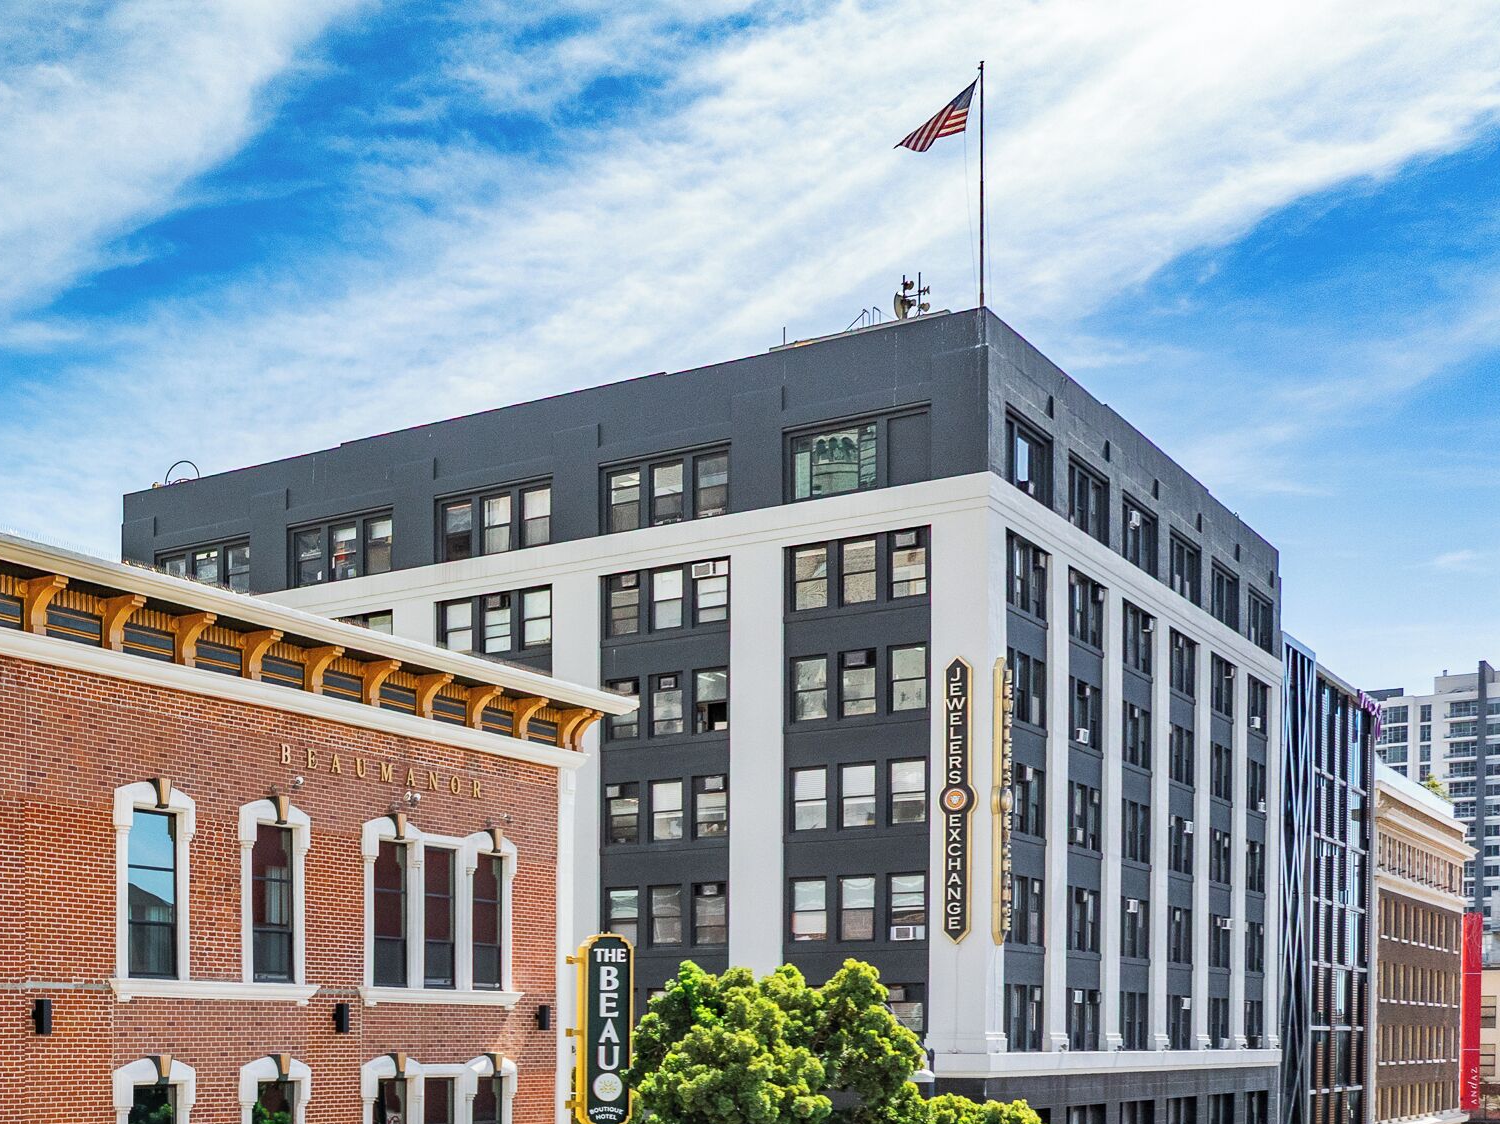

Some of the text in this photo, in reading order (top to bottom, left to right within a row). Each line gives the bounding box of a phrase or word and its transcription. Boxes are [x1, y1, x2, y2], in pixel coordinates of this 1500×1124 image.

[279, 743, 482, 799] BEAUMANOR
[946, 667, 966, 930] JEWELERS EXCHANGE
[593, 948, 627, 963] THE
[597, 965, 621, 1071] BEAU
[589, 1106, 624, 1116] BOUTIQUE
[595, 1113, 617, 1121] HOTEL
